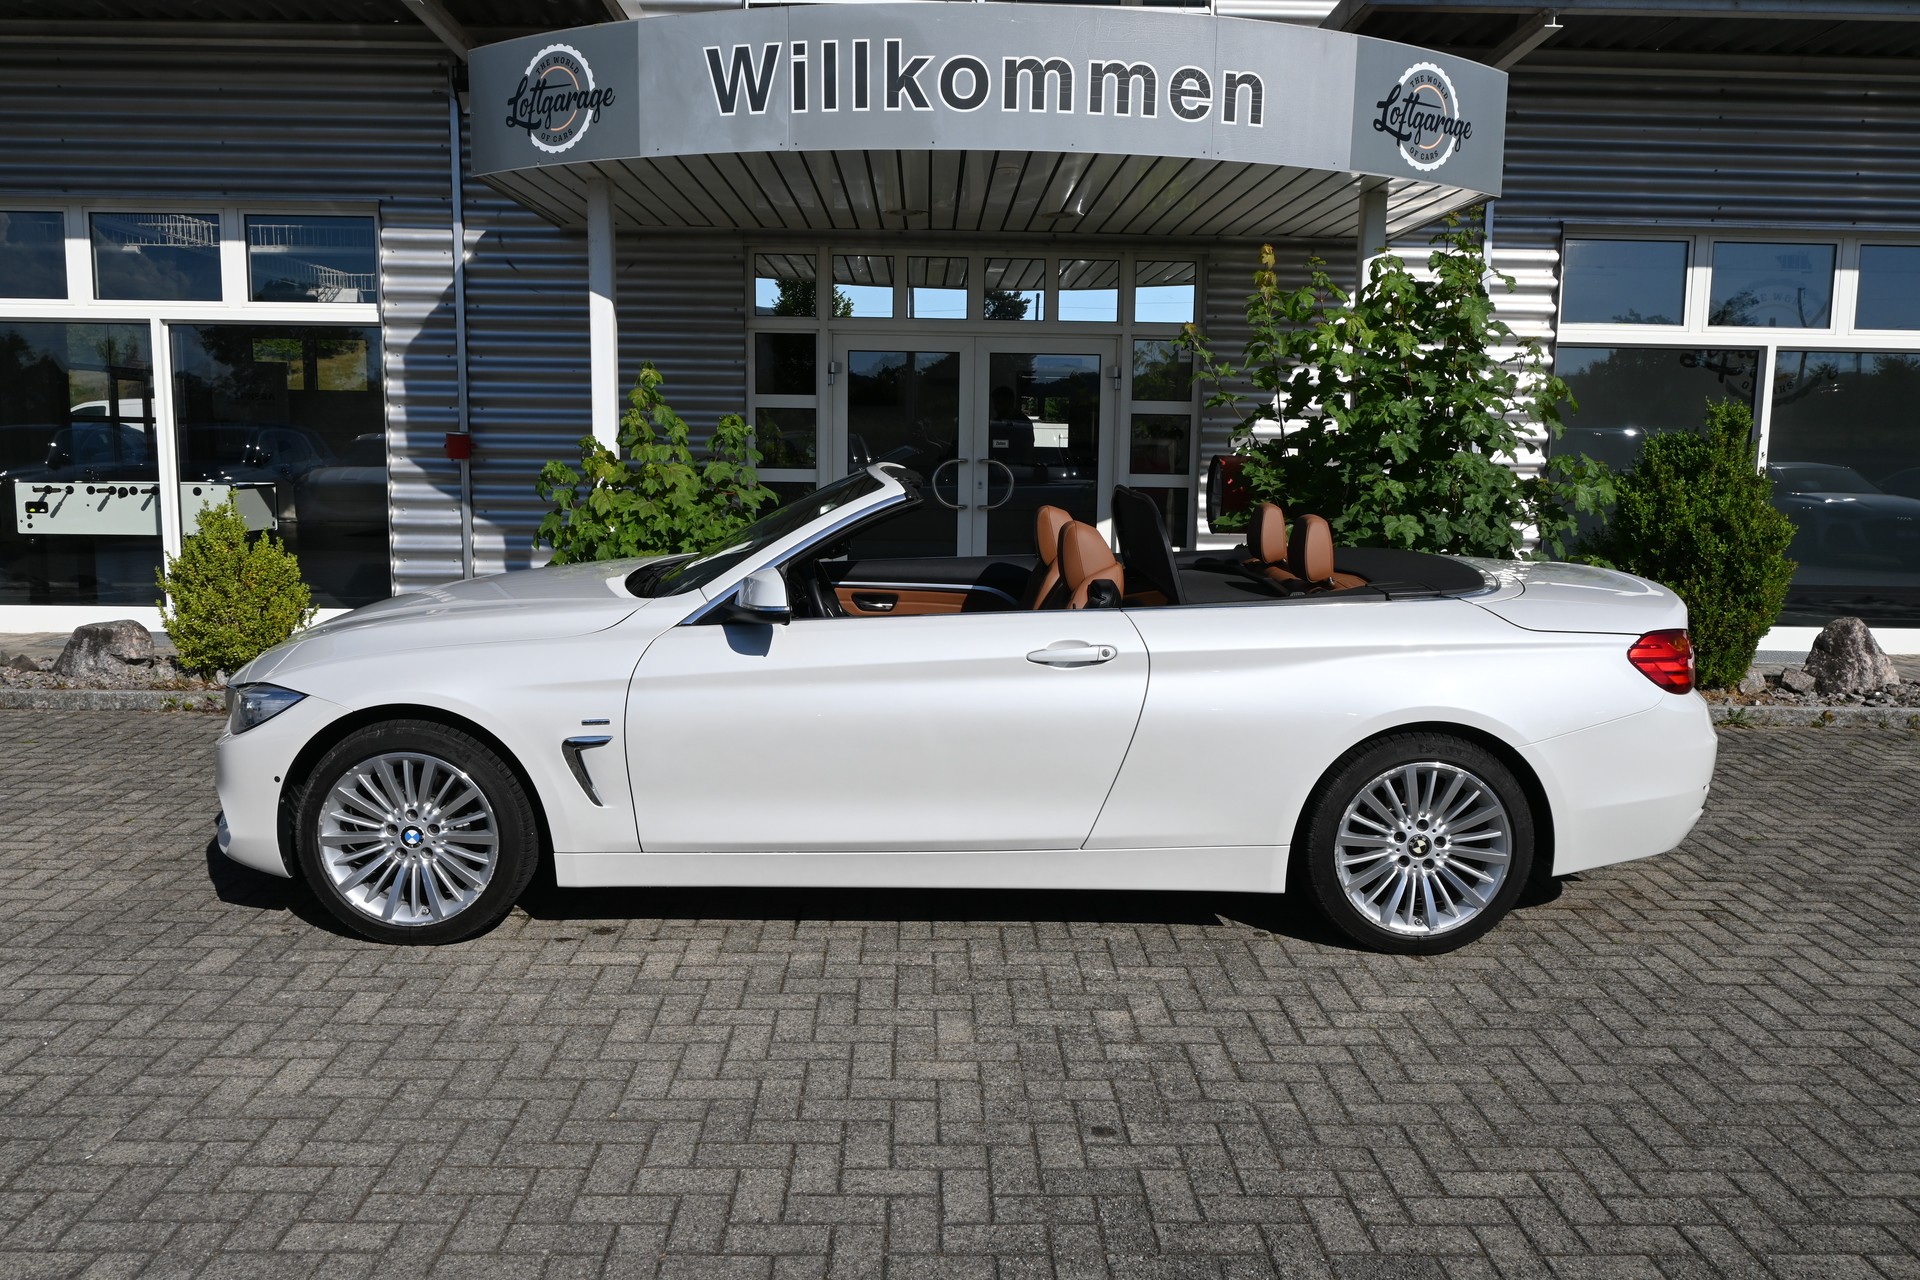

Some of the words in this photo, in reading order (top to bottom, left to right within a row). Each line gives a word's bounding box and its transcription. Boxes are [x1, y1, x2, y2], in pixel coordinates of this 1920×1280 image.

[535, 58, 551, 75] THE
[553, 56, 580, 75] WORLD
[702, 38, 1265, 128] Willkommen
[1409, 75, 1425, 88] THE
[1427, 75, 1449, 100] WORLD
[505, 74, 616, 137] Loftgarage
[1373, 84, 1473, 152] Loftgarage
[540, 132, 551, 142] OF
[553, 129, 573, 142] CARS
[1409, 147, 1418, 157] OF
[1420, 150, 1439, 160] CARS
